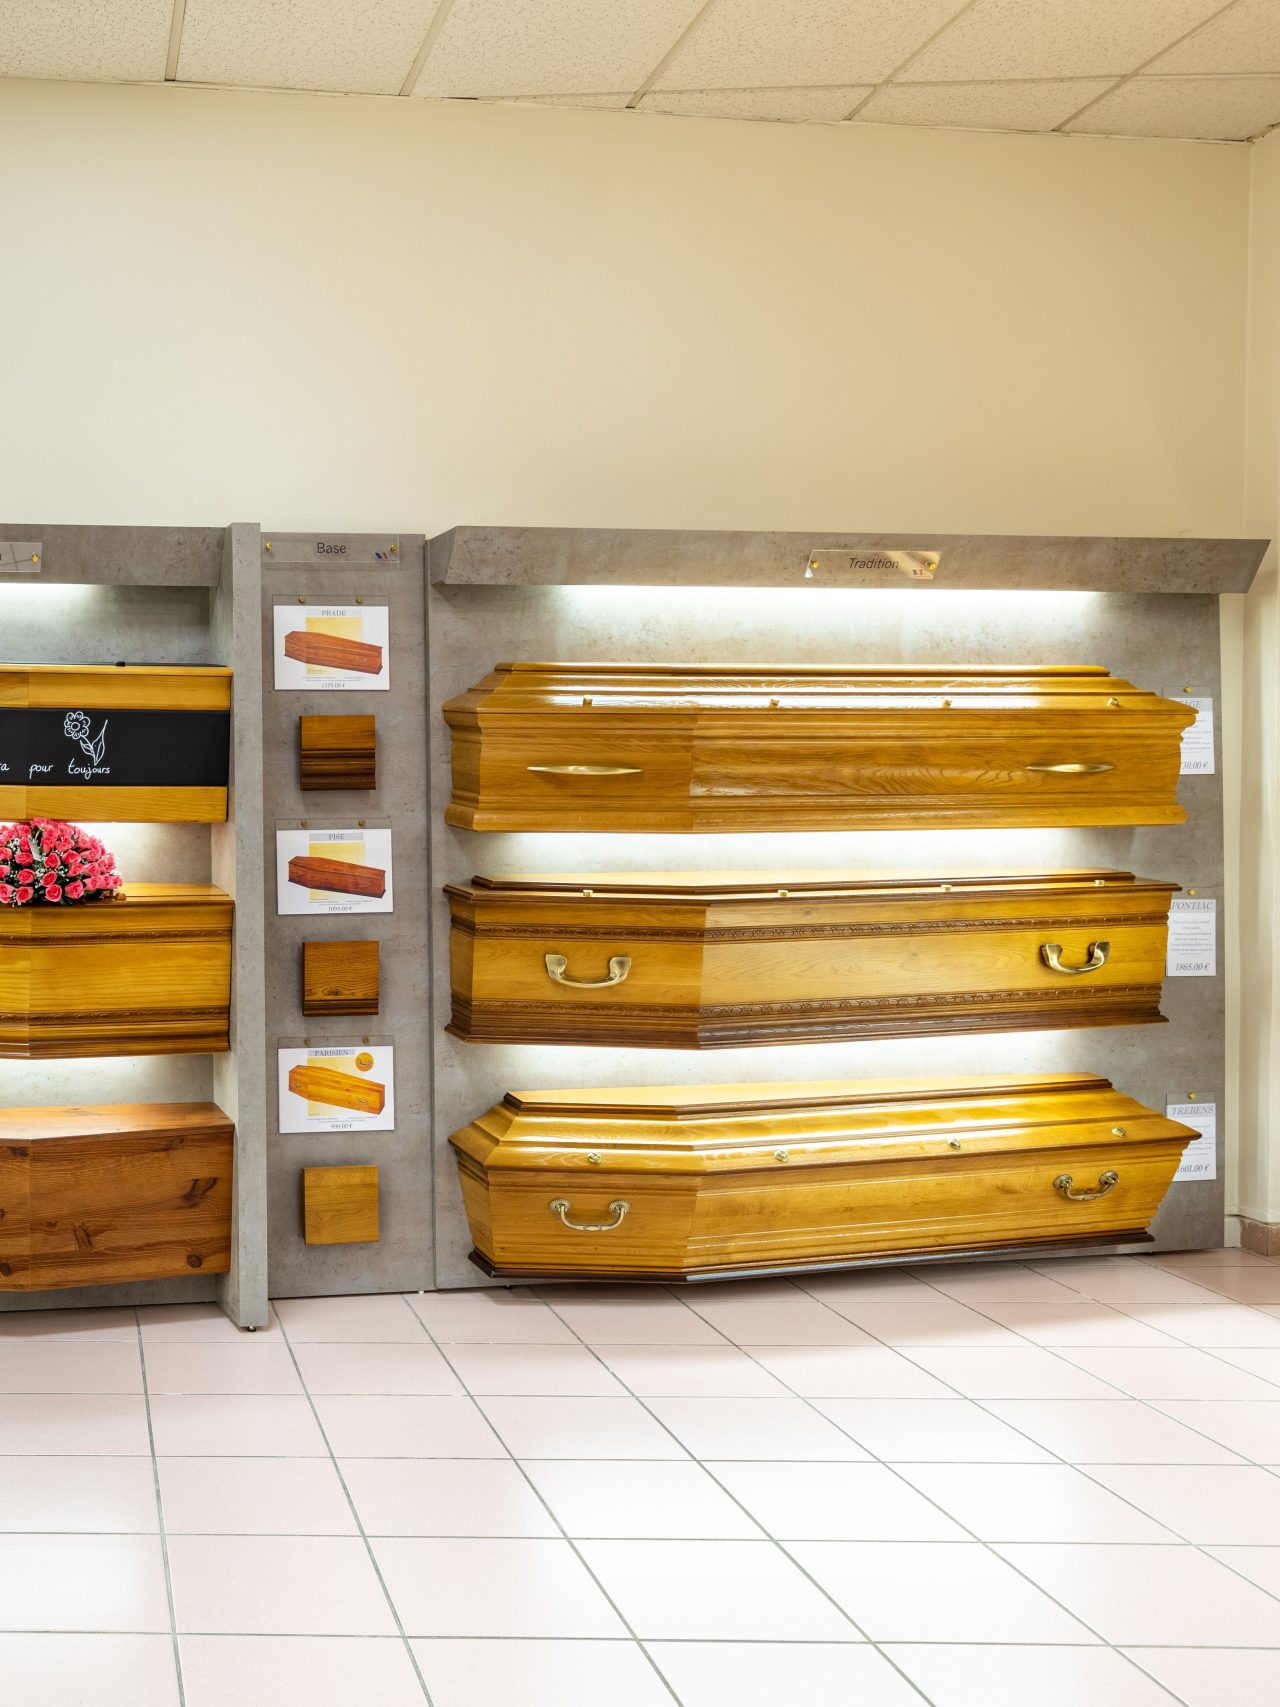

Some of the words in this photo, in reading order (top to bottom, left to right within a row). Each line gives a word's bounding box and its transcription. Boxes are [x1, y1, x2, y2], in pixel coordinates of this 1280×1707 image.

[316, 542, 347, 554] Base
[848, 557, 900, 569] Tradition
[29, 763, 54, 779] pour
[67, 757, 111, 780] toujours
[1171, 901, 1213, 910] PONTIAC
[1204, 963, 1210, 971] €
[314, 1049, 349, 1057] PARISIEN
[1178, 1164, 1203, 1173] 601.00
